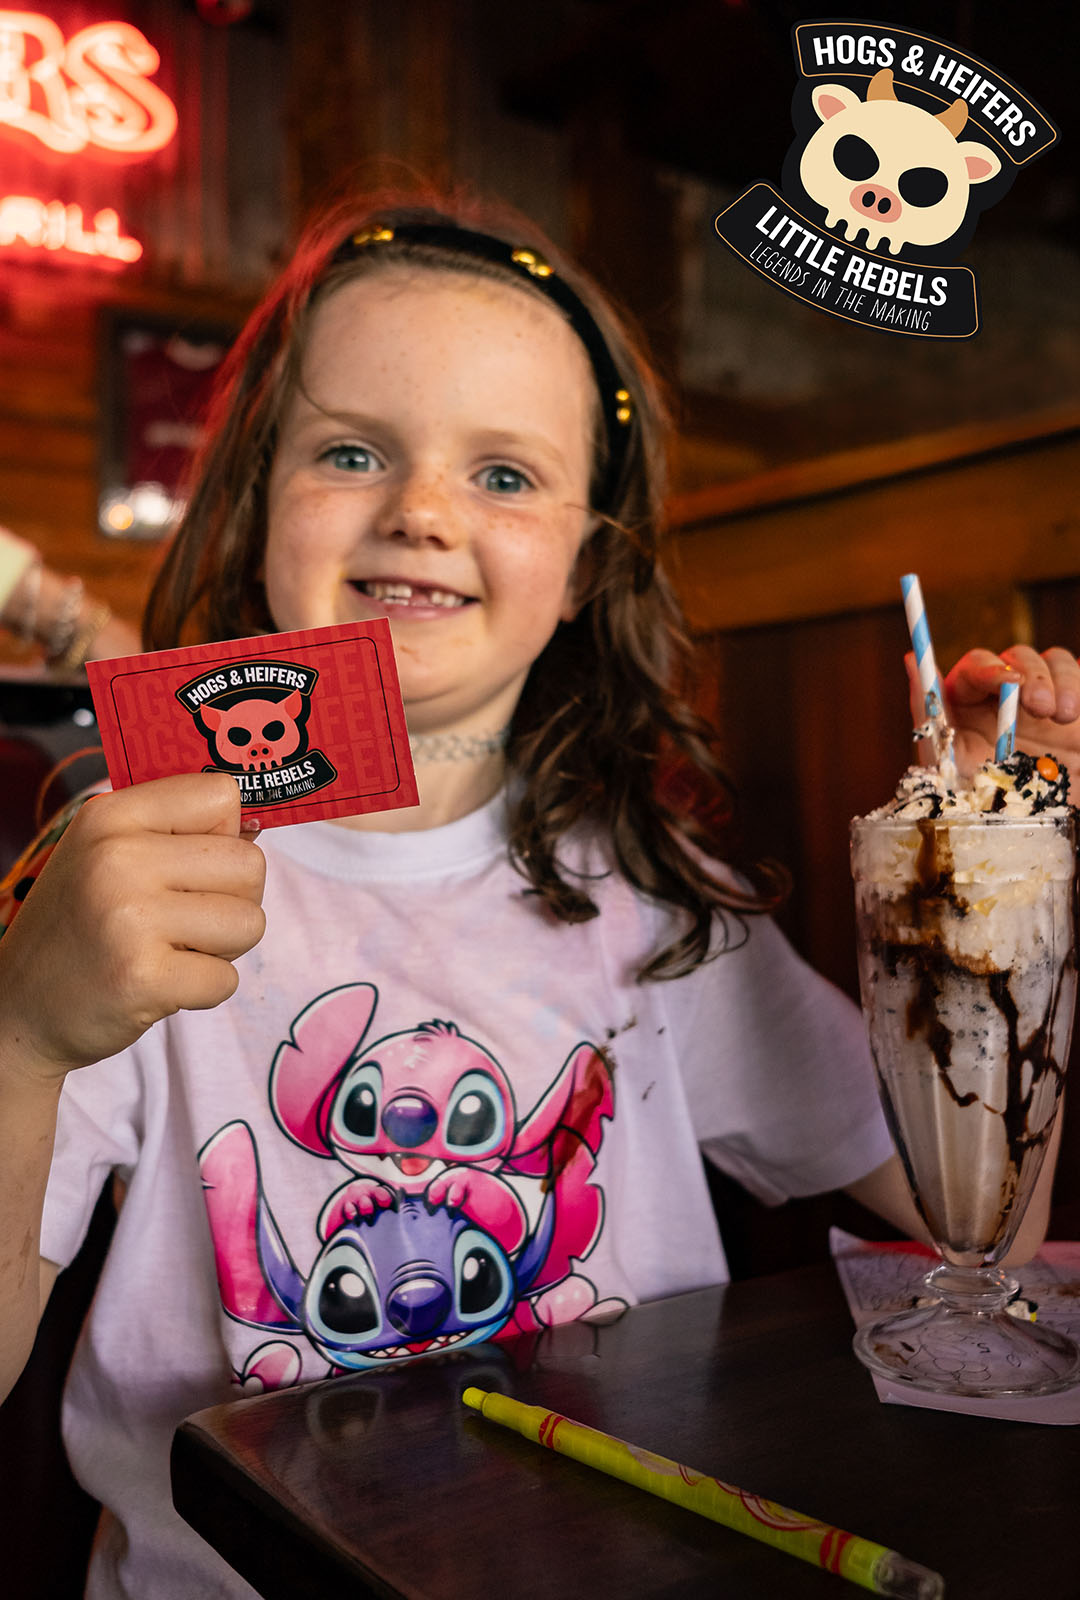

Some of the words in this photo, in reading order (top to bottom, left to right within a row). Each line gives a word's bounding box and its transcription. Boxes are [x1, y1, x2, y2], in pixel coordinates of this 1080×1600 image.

[186, 674, 228, 707] HOGS
[229, 670, 243, 686] &
[245, 666, 308, 689] HEIFERS
[263, 760, 316, 789] REBELS
[256, 790, 265, 801] IN
[285, 778, 316, 797] MAKING
